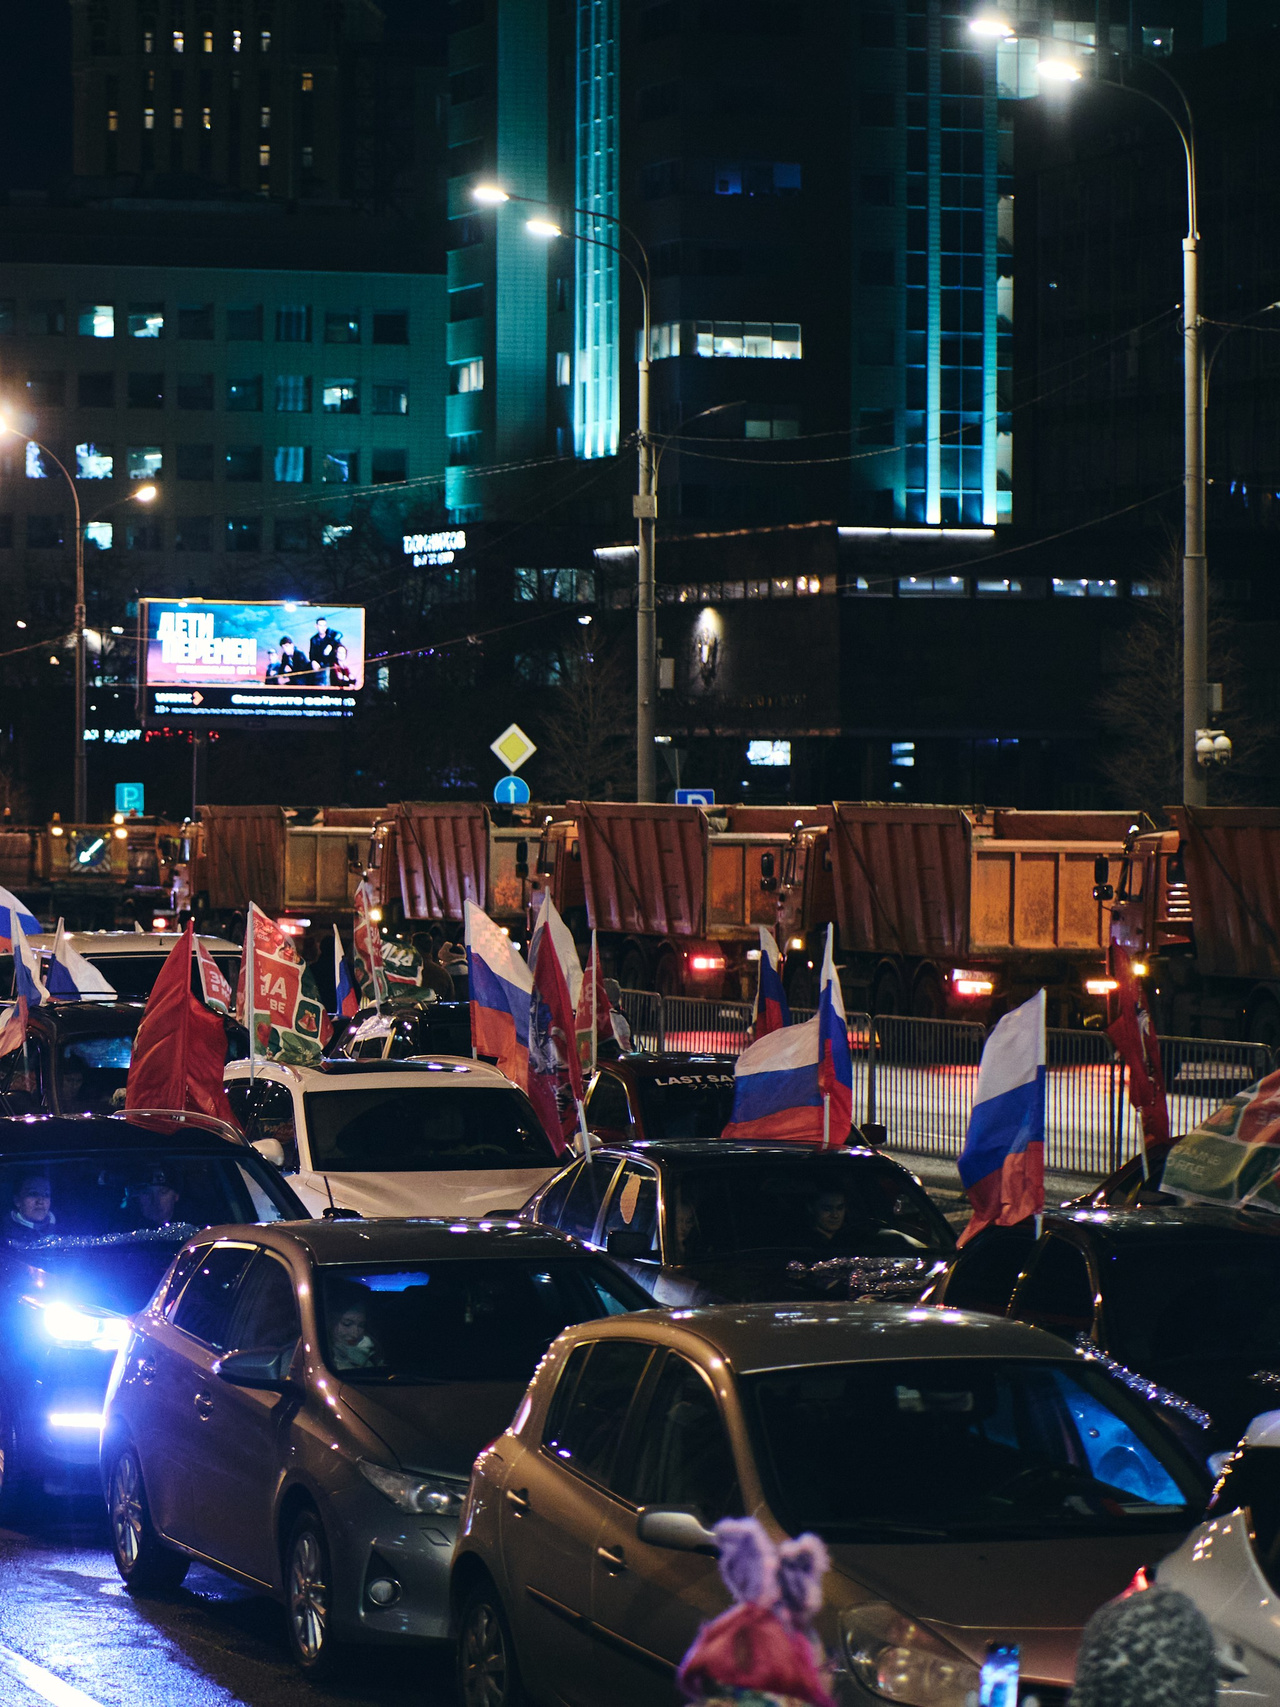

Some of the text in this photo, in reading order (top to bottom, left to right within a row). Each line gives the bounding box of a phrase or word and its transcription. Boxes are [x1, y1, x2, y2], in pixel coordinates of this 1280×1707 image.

[157, 612, 214, 640] ДЕТИ
[162, 638, 257, 665] ПЕРЕМЕН
[124, 787, 139, 809] P
[654, 1074, 736, 1087] LAST SA
